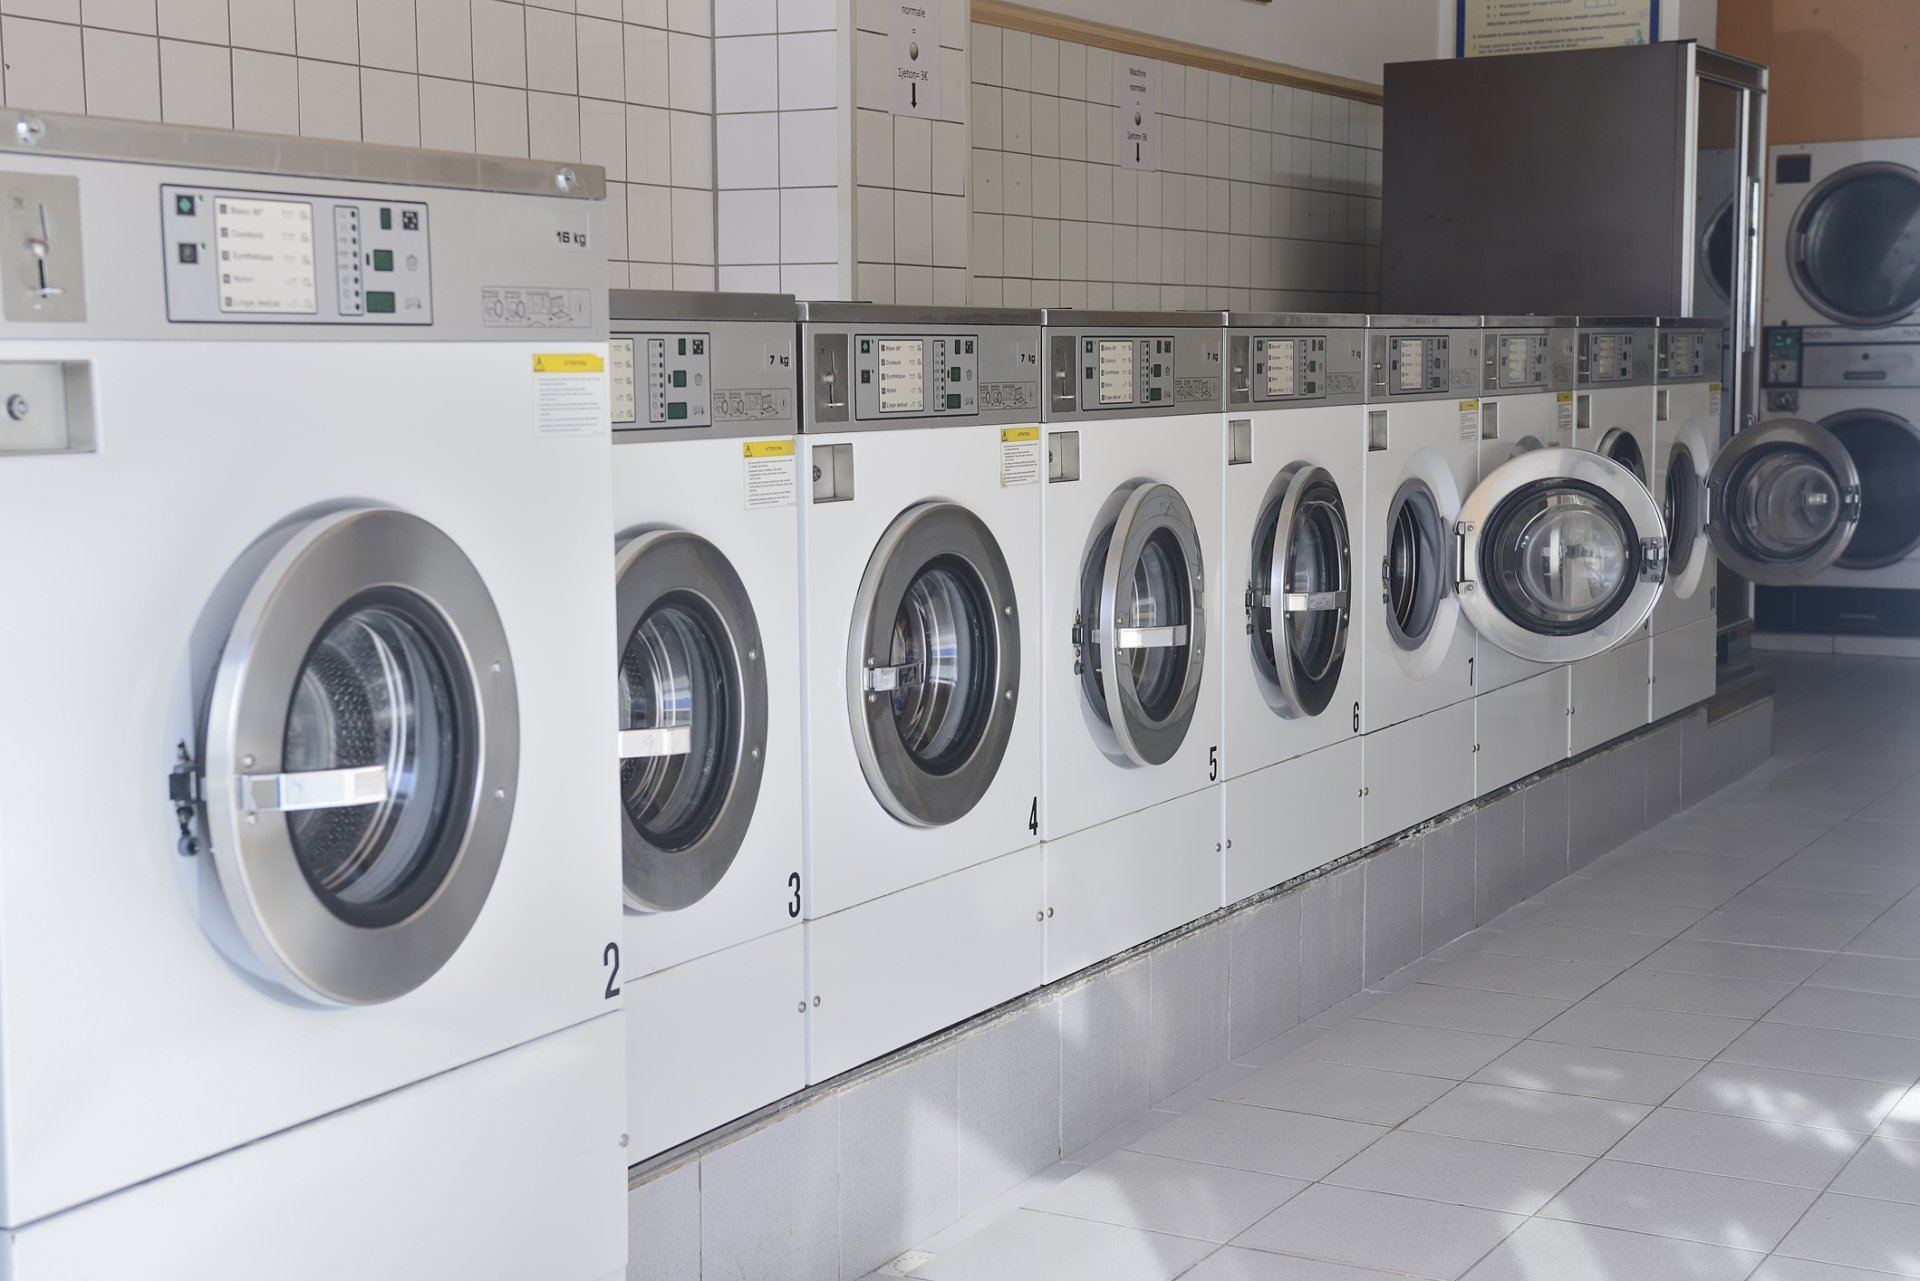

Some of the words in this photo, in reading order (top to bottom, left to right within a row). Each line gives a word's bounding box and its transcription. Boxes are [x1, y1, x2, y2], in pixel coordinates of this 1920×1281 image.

[901, 6, 926, 18] normale
[556, 231, 570, 244] 16
[573, 231, 587, 248] kg
[769, 355, 775, 365] 7
[779, 354, 789, 367] kg
[1020, 354, 1025, 363] 7
[1028, 353, 1036, 364] kg
[1468, 657, 1474, 686] 7
[1352, 701, 1359, 733] 6
[1209, 745, 1217, 781] 5
[1028, 796, 1039, 835] 4
[788, 871, 801, 918] 3
[603, 942, 620, 1000] 2
